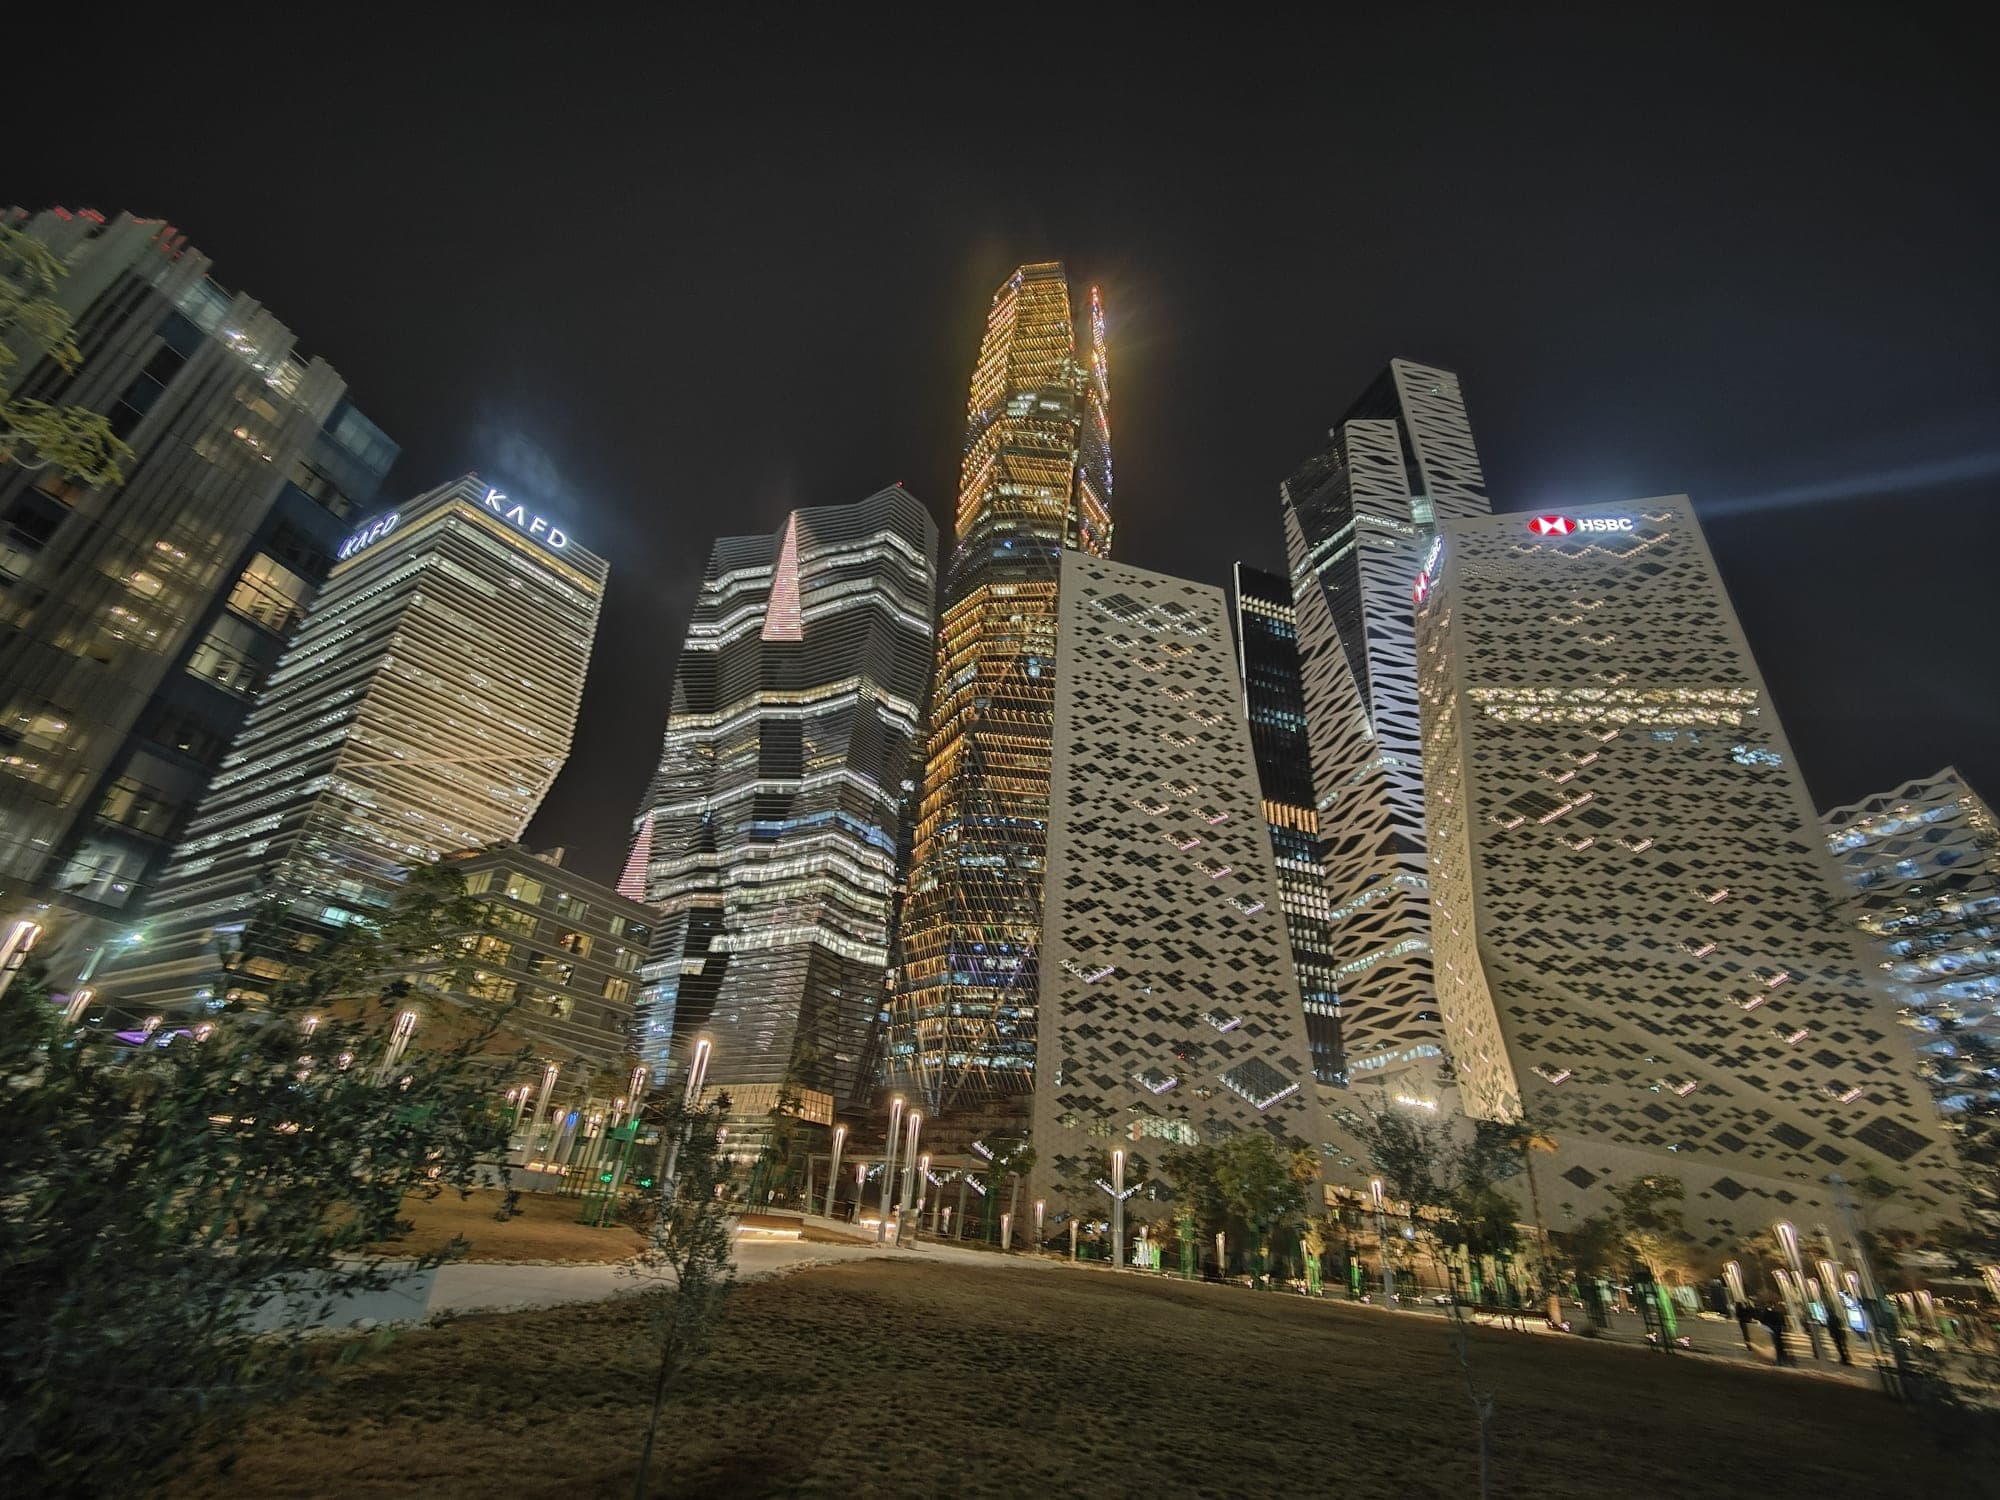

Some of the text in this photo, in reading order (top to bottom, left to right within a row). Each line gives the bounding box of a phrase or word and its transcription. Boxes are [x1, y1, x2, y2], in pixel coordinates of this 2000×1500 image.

[338, 512, 400, 559] KAFD
[485, 489, 567, 547] KAFD
[1578, 518, 1634, 532] HSBC
